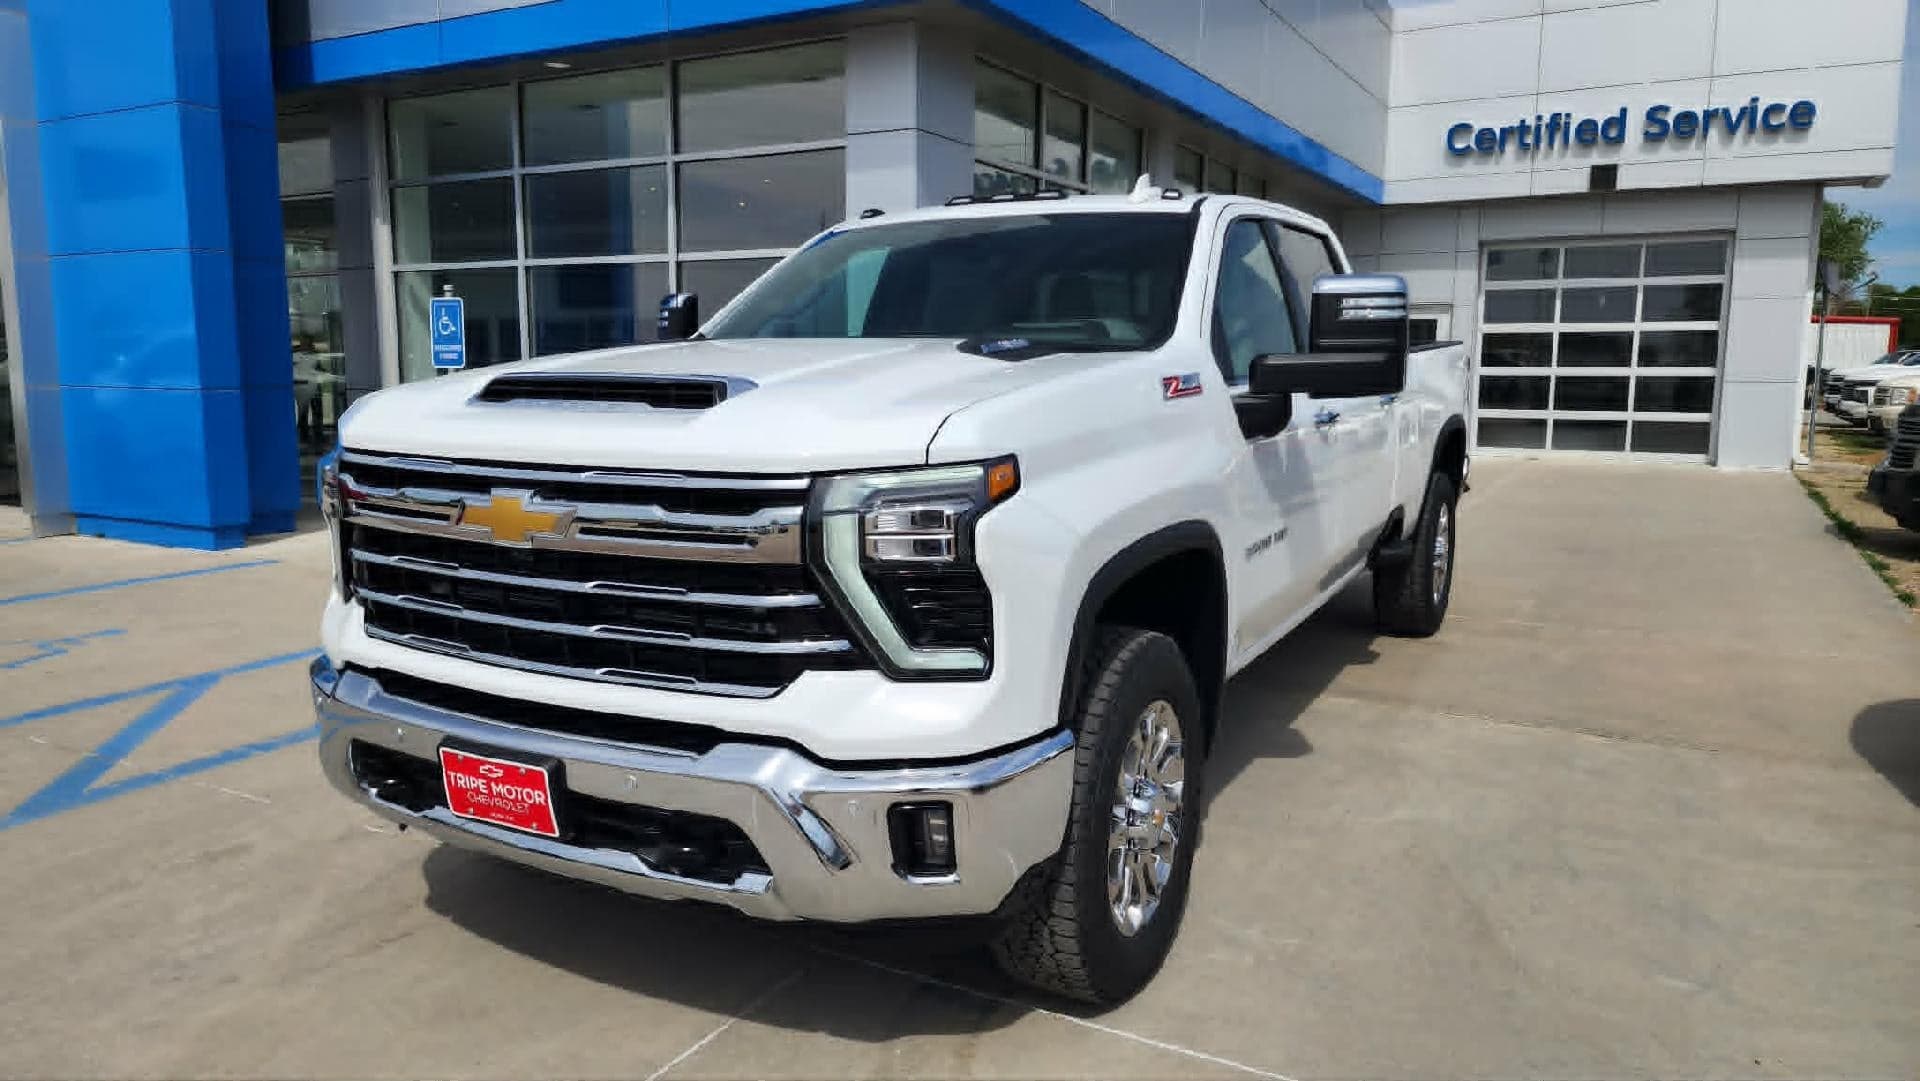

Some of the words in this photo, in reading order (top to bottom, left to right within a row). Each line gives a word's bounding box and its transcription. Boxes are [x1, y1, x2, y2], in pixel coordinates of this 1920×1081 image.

[1447, 106, 1628, 156] Certified
[1643, 96, 1817, 142] Service
[447, 771, 489, 794] TRIPE
[490, 781, 546, 806] MOTOR
[466, 791, 530, 815] CHEVROLET
